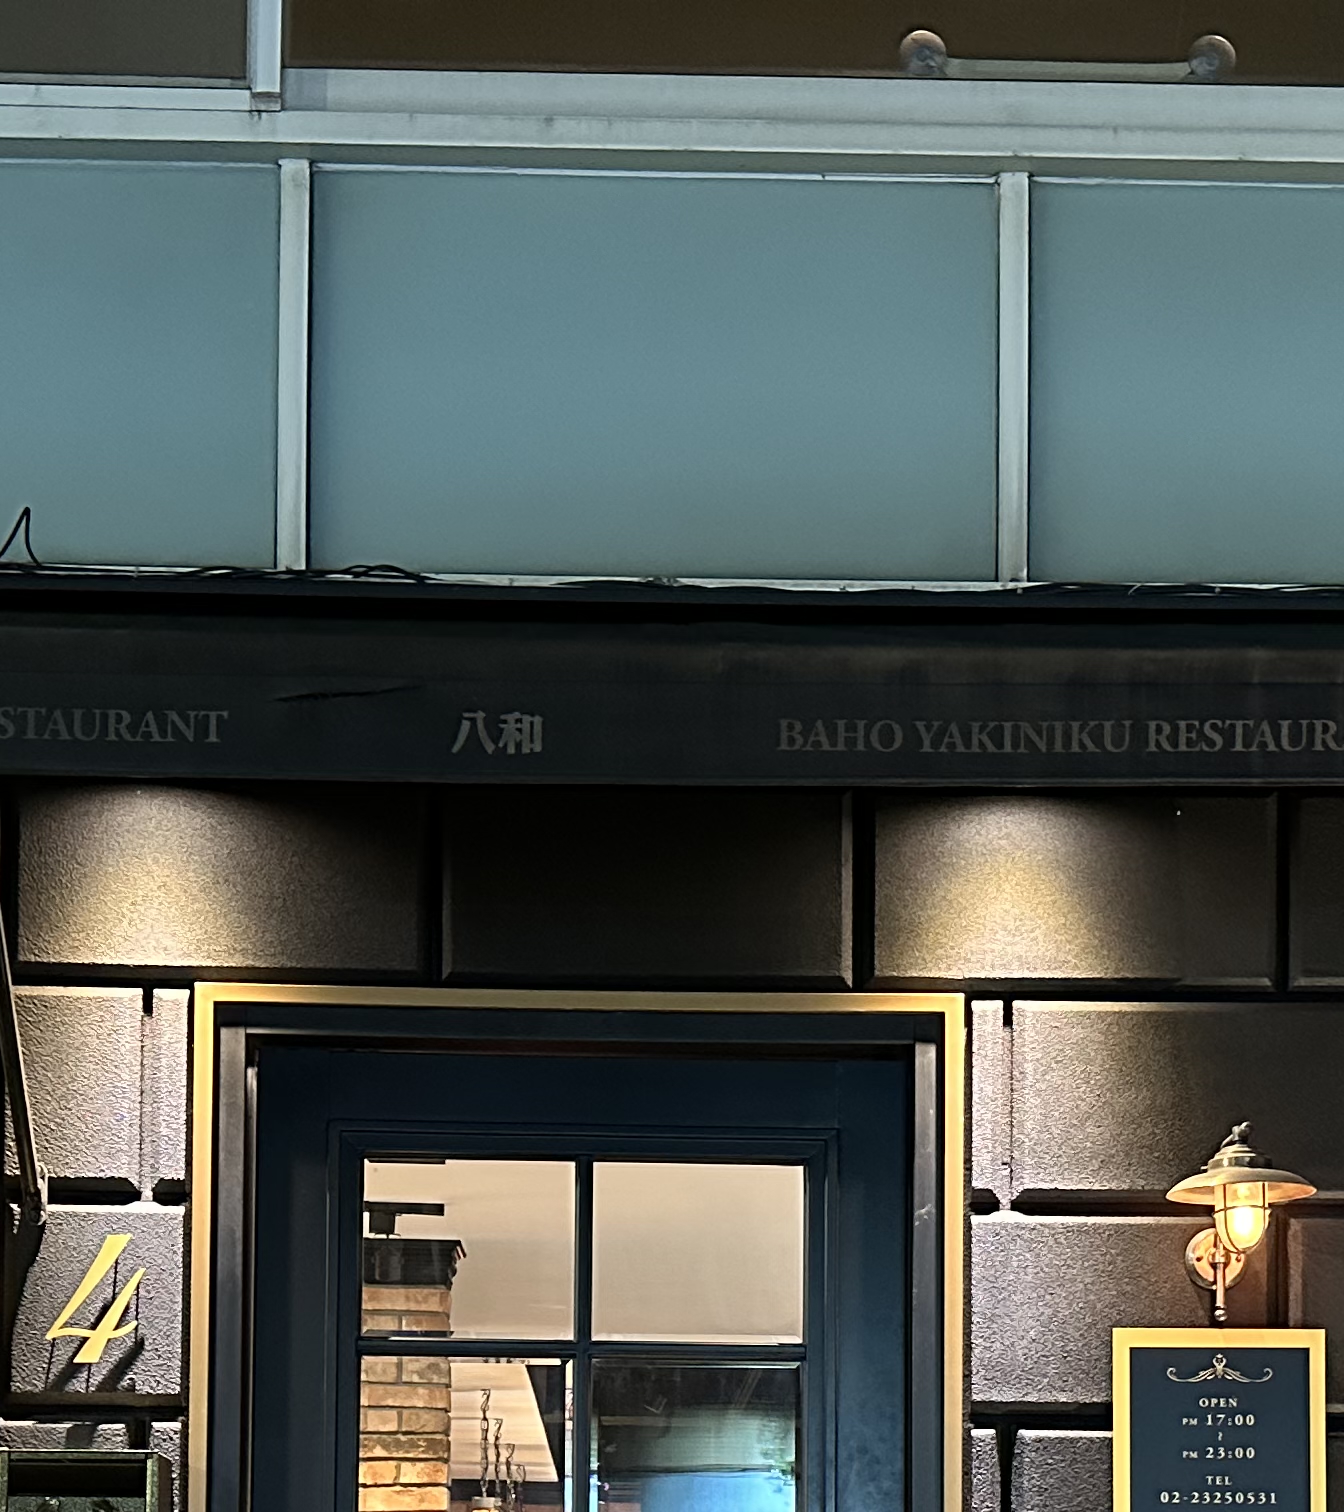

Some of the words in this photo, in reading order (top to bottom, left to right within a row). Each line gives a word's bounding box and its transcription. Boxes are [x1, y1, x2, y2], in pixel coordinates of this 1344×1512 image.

[451, 709, 544, 756] 八和
[777, 716, 905, 752] BAHO
[914, 717, 1133, 754] YAKINIKU
[45, 1234, 146, 1364] 4
[1199, 1397, 1238, 1408] OPEN
[1182, 1418, 1198, 1426] PM
[1205, 1414, 1255, 1426] 17:00
[1182, 1450, 1198, 1459] PM
[1205, 1448, 1255, 1459] 23:00
[1206, 1475, 1232, 1485] TEL
[1160, 1492, 1277, 1504] 02-23250531
